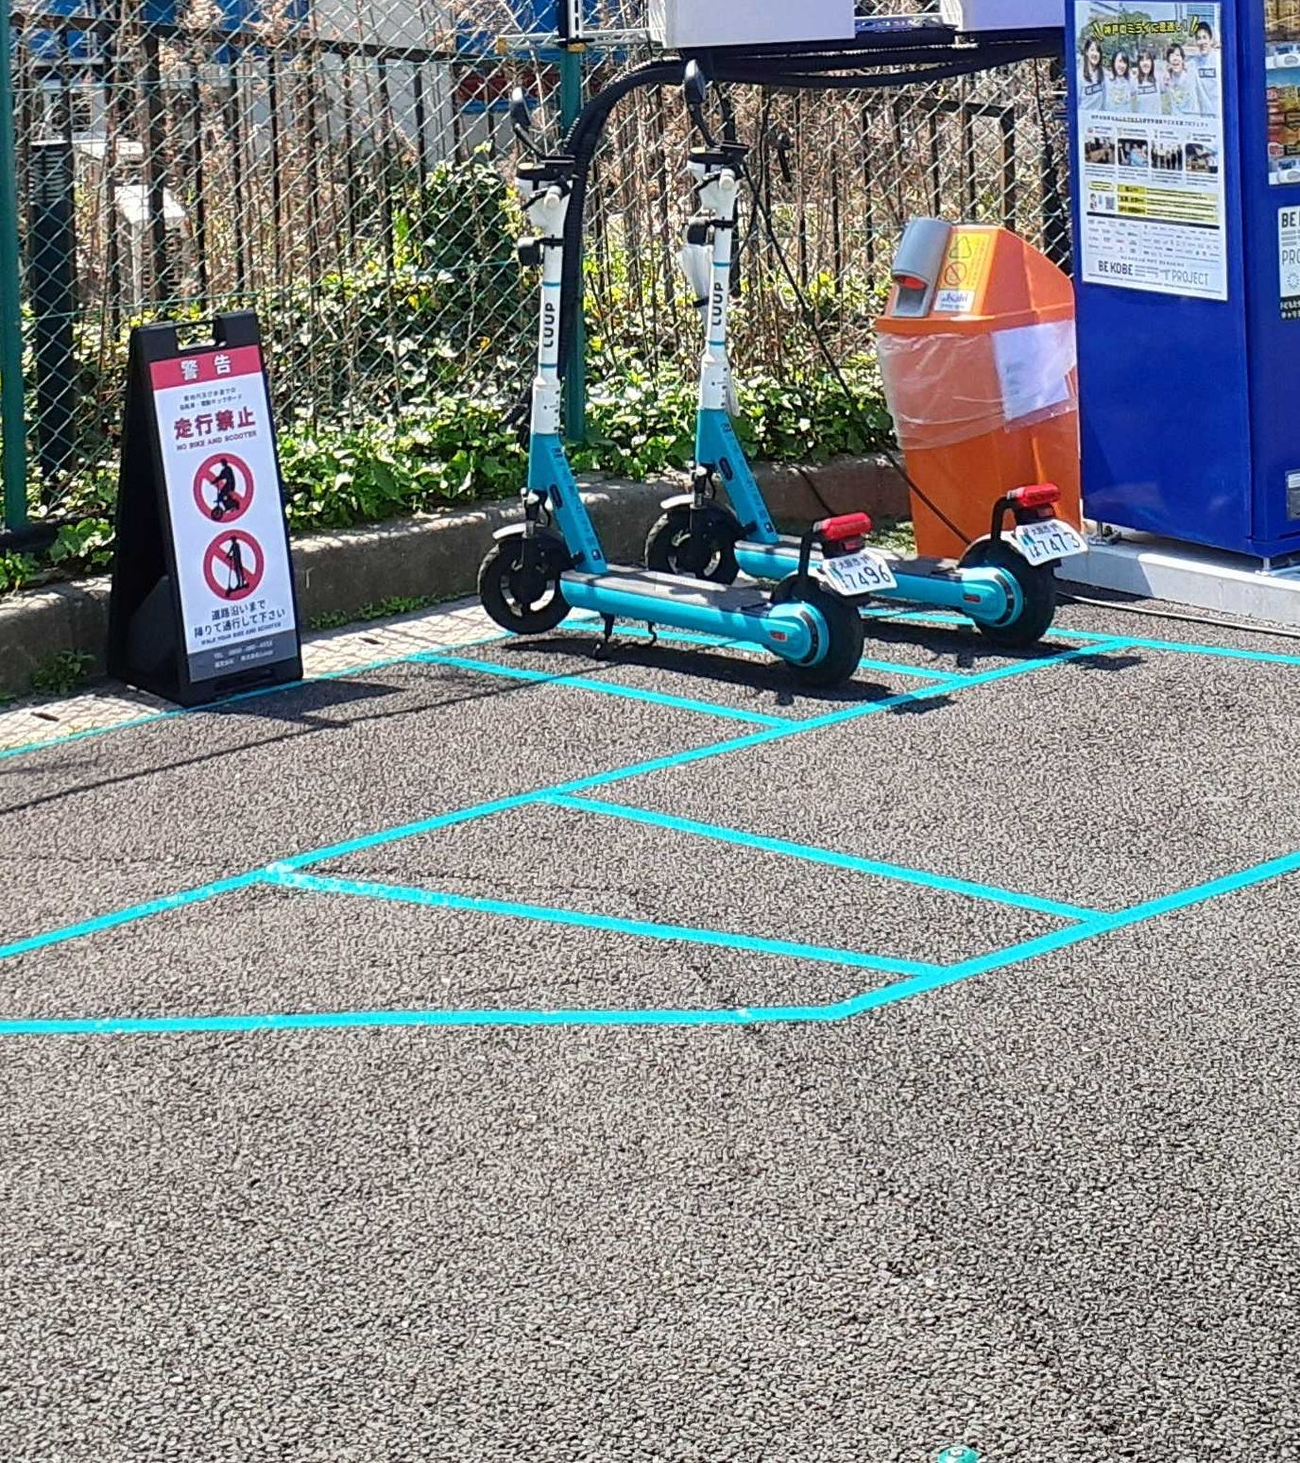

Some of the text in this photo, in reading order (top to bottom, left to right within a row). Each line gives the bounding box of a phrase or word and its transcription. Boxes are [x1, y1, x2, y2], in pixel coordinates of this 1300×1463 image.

[1281, 211, 1296, 228] BE
[1098, 260, 1108, 273] BE
[1110, 261, 1133, 276] KOBE
[1172, 269, 1208, 285] PROJECT
[711, 282, 723, 326] LUUP
[543, 302, 556, 348] LUUP
[181, 354, 231, 381] 警告
[174, 405, 256, 440] 走行禁止
[176, 430, 257, 450] NO BIKE AND SCOOTER
[845, 564, 891, 589] 7496
[194, 608, 286, 638] 降りて通行して下さい
[212, 599, 265, 621] 道路沿いまで
